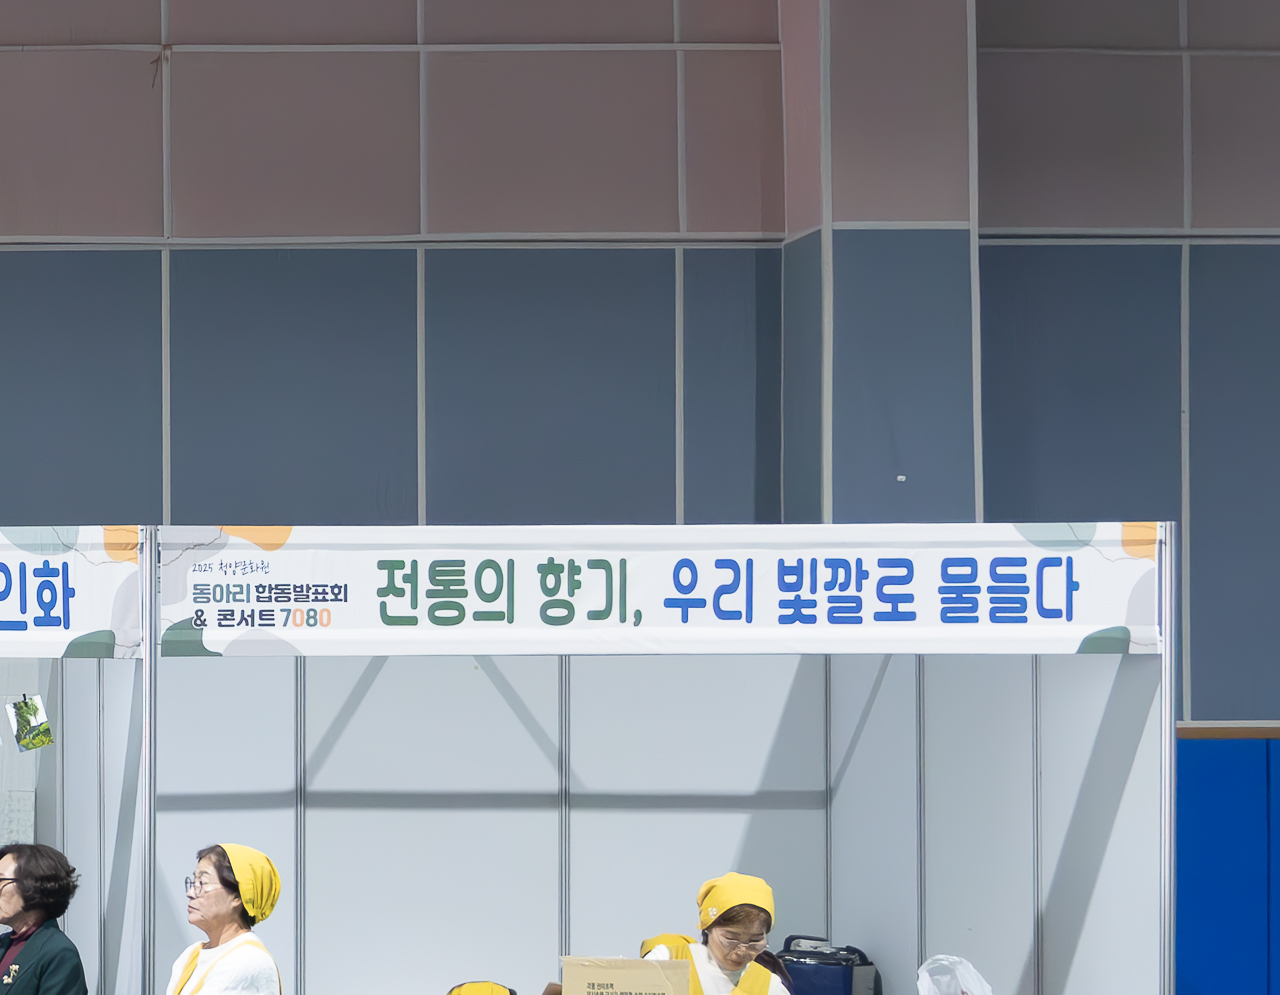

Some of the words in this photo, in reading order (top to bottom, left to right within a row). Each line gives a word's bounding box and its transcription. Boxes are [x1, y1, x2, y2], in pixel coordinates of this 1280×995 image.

[193, 563, 213, 573] 2025
[219, 560, 270, 576] 청양문화원
[193, 584, 250, 603] 동아리
[255, 584, 348, 603] 합동발표회
[377, 559, 514, 626] 전통의
[537, 557, 642, 627] 향기,
[663, 558, 753, 624] 우리
[777, 558, 917, 624] 빛깔로
[938, 556, 1080, 623] 물들다
[193, 609, 207, 627] &
[217, 609, 275, 627] 콘서트
[280, 608, 331, 627] 7080
